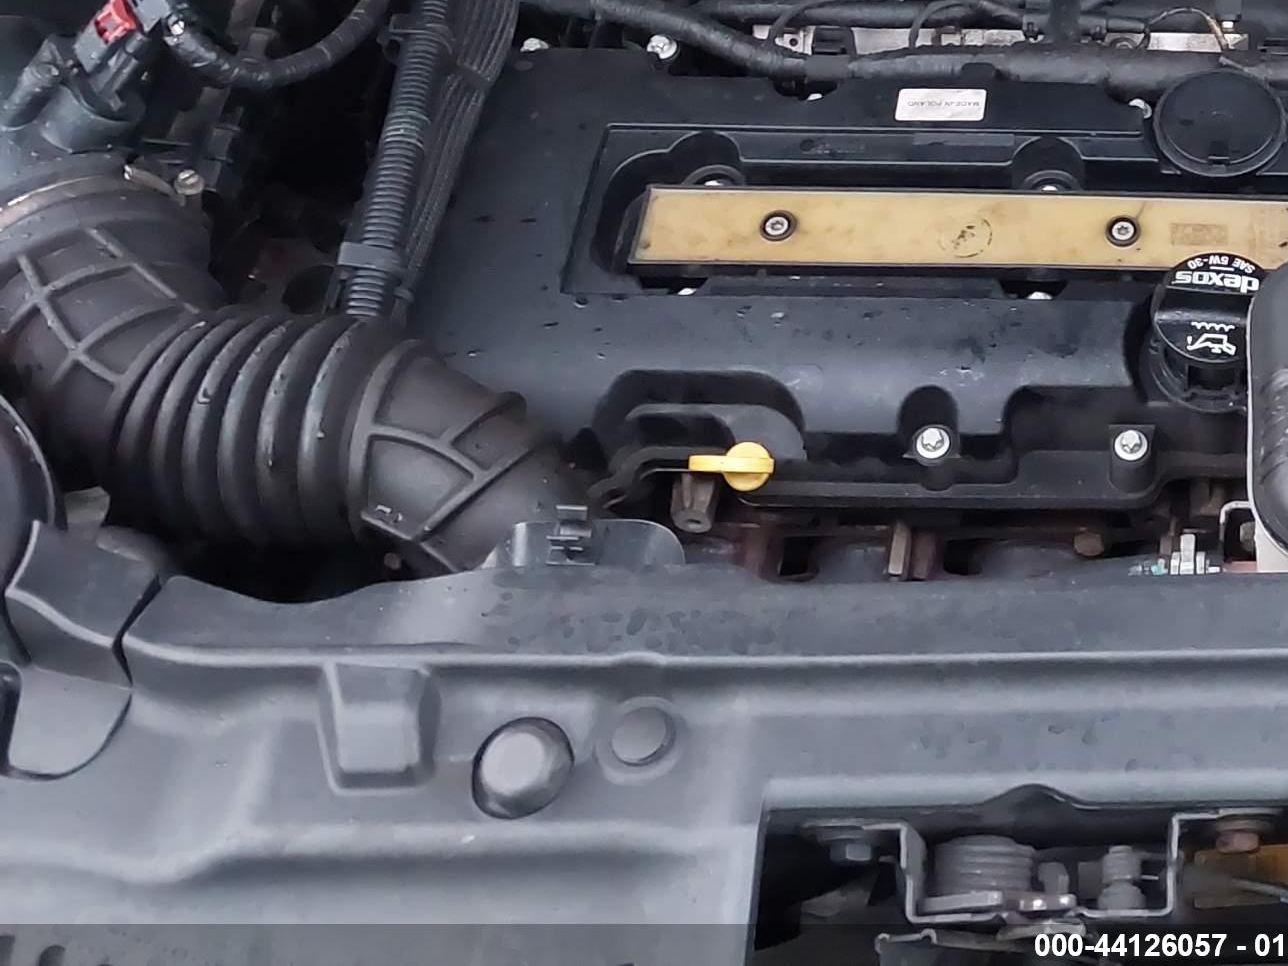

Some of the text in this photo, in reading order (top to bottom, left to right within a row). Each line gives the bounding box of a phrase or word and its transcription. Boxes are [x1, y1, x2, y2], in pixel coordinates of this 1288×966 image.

[1187, 254, 1256, 274] SAE 5W-30
[1171, 270, 1260, 294] dexos
